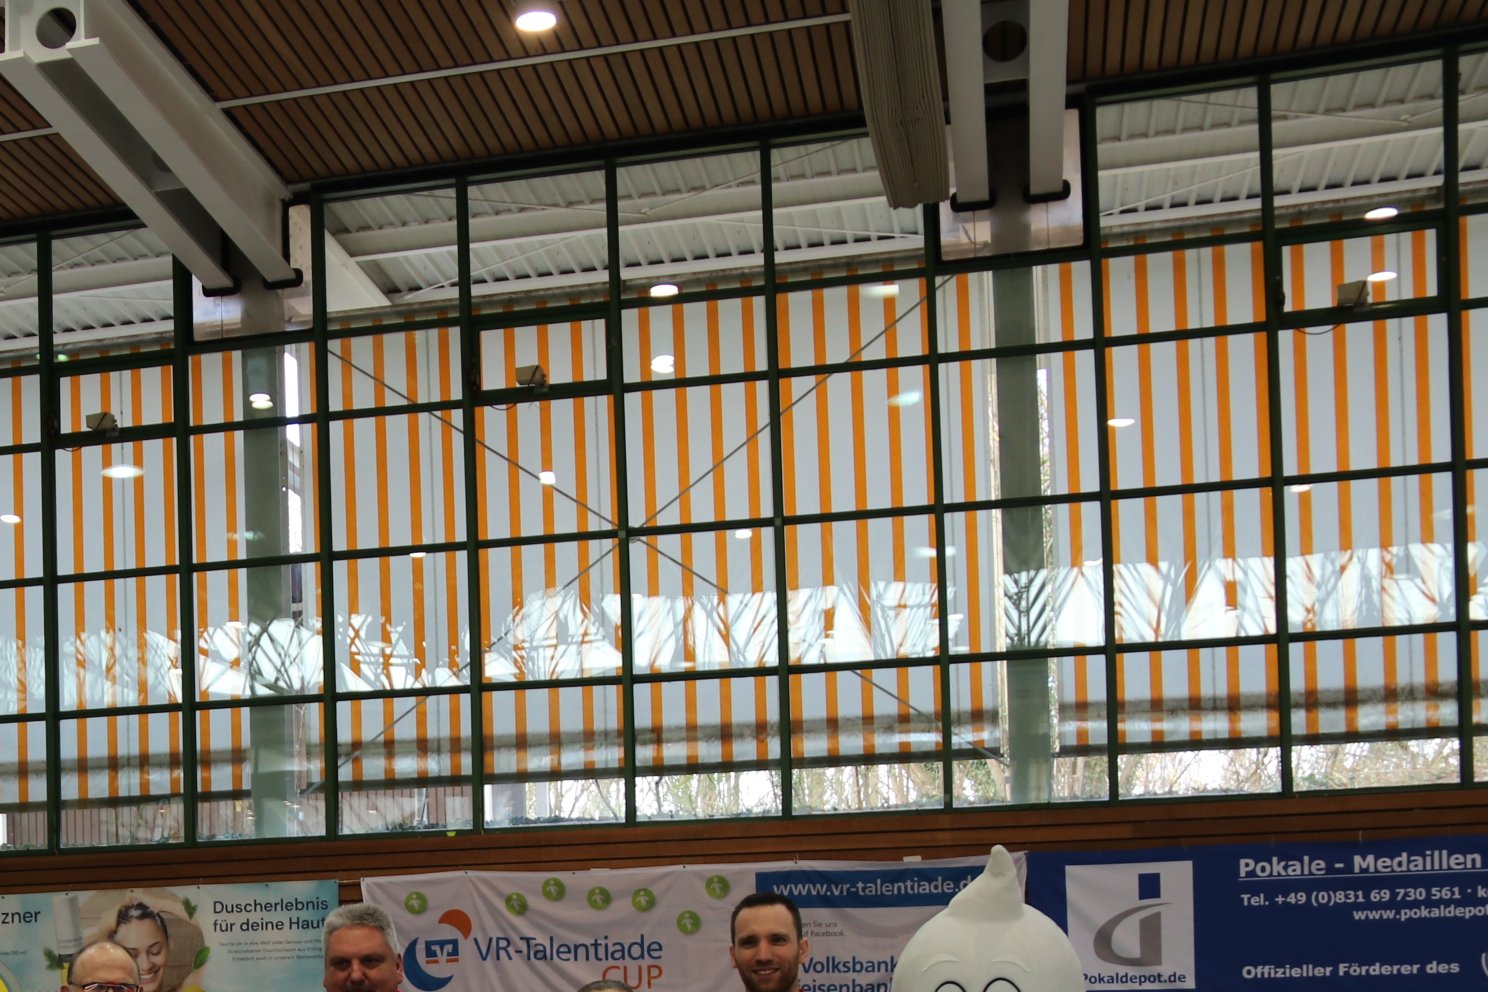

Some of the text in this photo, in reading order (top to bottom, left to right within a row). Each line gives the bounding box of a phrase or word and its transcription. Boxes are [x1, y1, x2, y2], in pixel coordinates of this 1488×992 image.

[1238, 856, 1326, 878] Pokale
[1352, 850, 1482, 873] Medaillen
[773, 875, 971, 897] www.vr-talentiade.d
[1241, 893, 1269, 906] Tel.
[1275, 892, 1306, 905] +49
[1311, 889, 1365, 907] (0)831
[1370, 889, 1391, 902] 69
[1395, 887, 1426, 901] 730
[1430, 886, 1462, 900] 561
[213, 897, 329, 914] Duscherlebnis
[213, 918, 236, 933] für
[240, 918, 285, 932] deine
[473, 934, 663, 962] VR-Talentiade
[1242, 960, 1460, 979] Offizieller Förderer des
